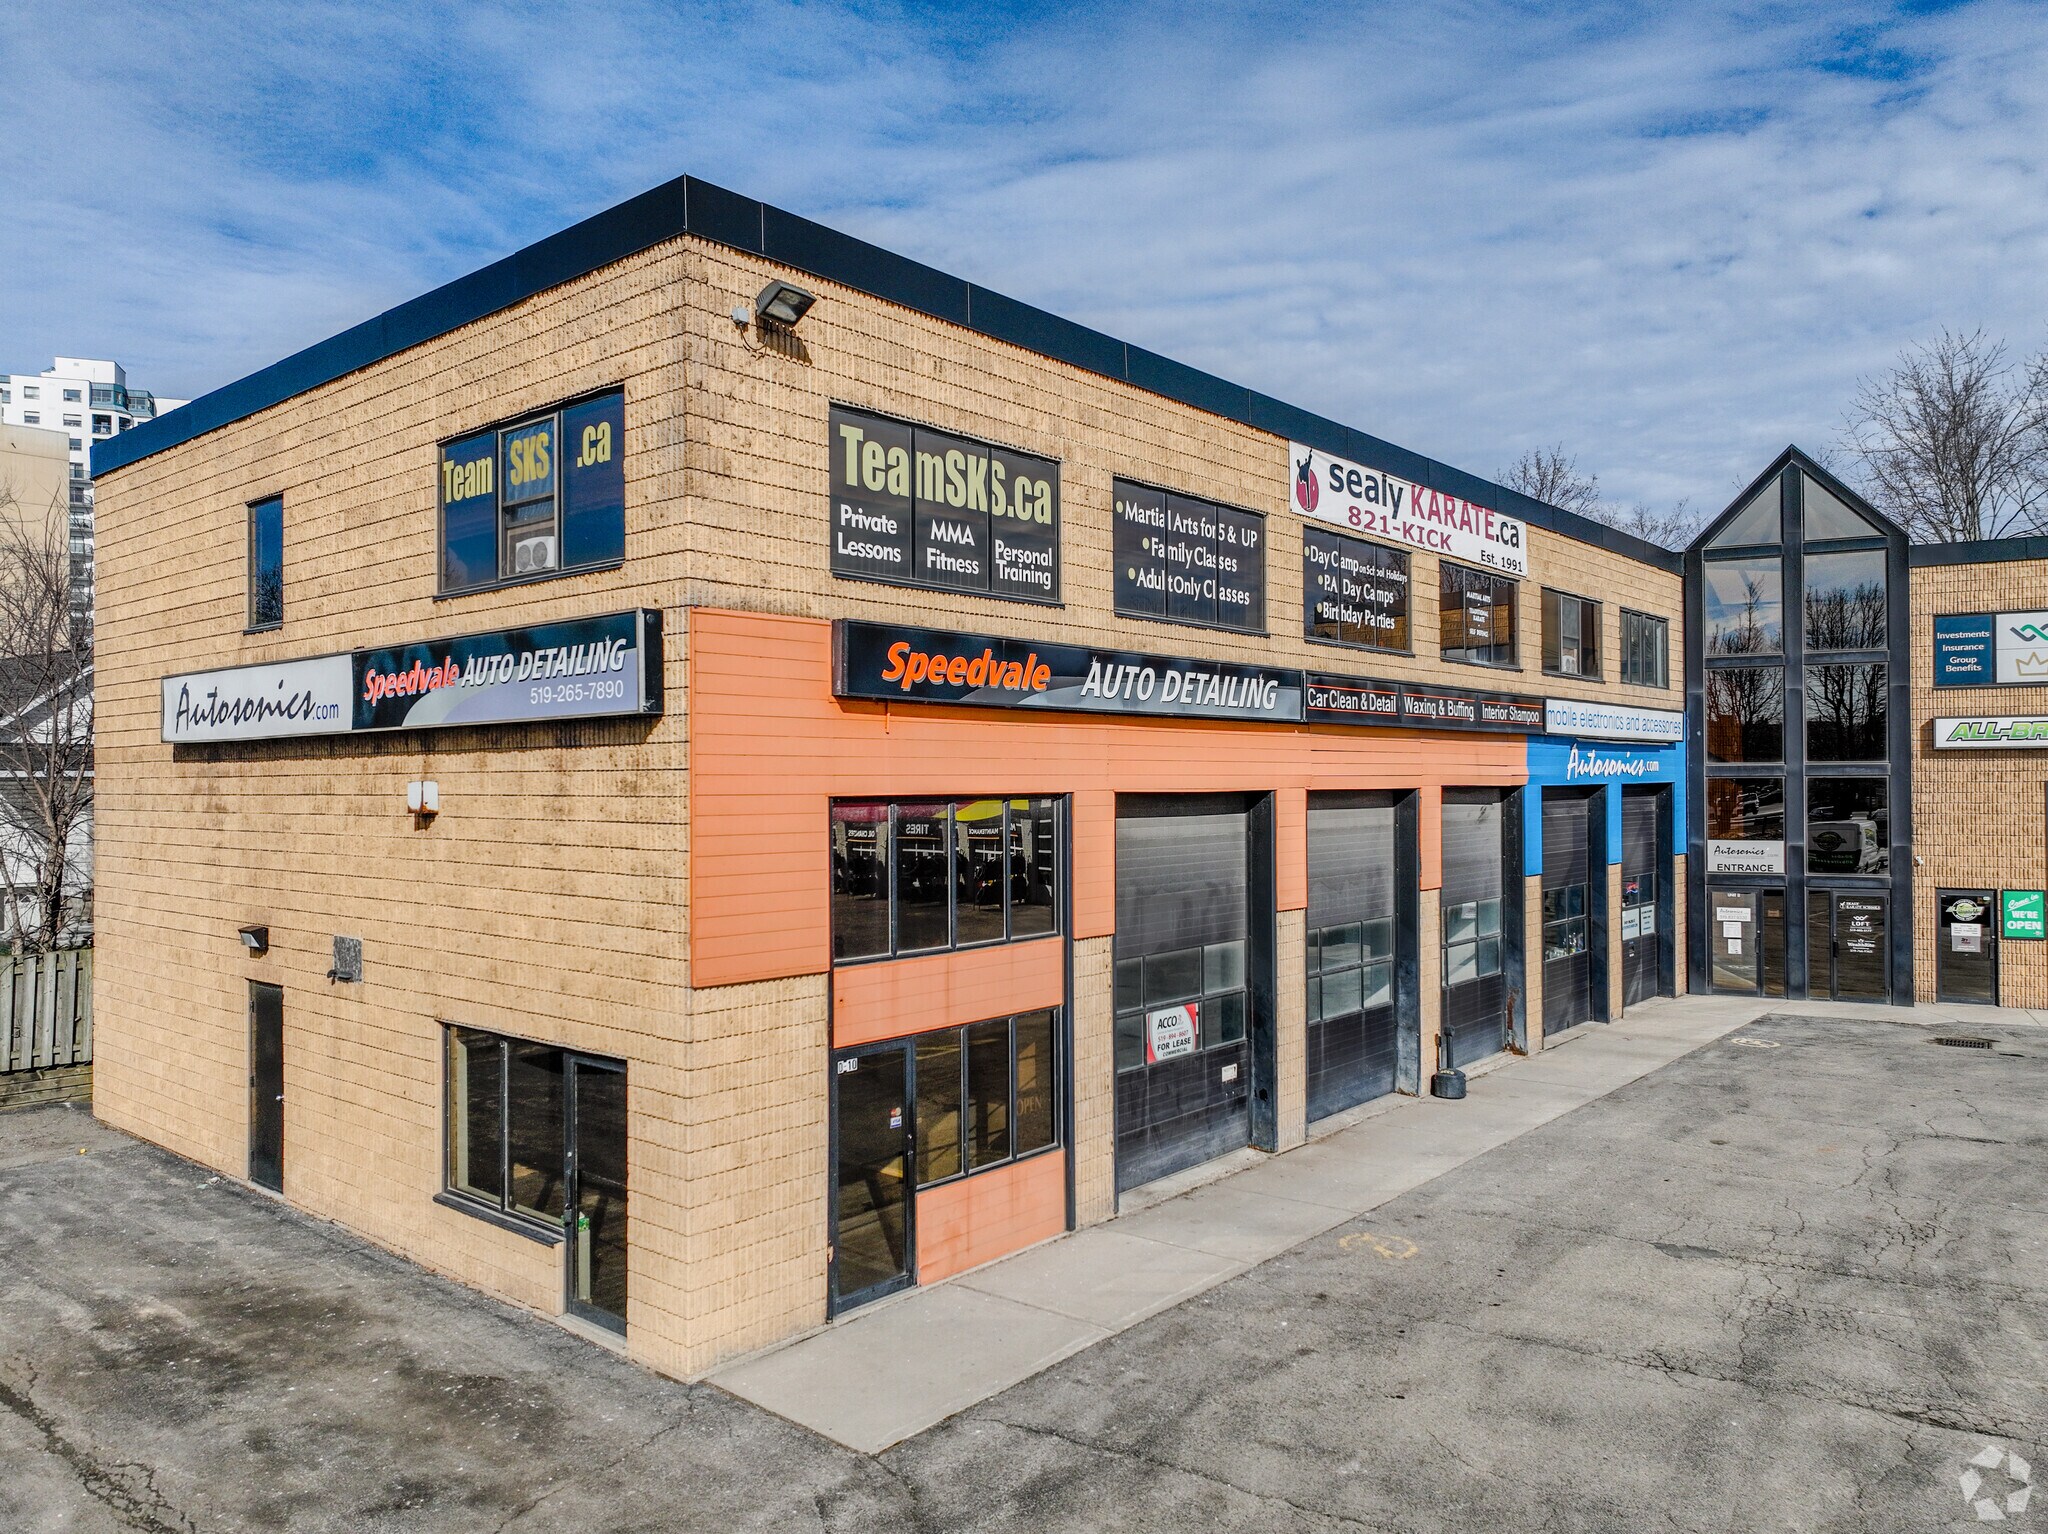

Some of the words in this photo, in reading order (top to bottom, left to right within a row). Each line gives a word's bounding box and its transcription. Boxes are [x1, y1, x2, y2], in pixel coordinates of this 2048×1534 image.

[443, 456, 493, 504] Team
[510, 432, 549, 486] SKS
[839, 423, 1052, 525] TeamSKS.ca
[840, 504, 897, 534] Private
[1329, 463, 1404, 519] sealy
[1410, 484, 1519, 549] KARATE.ca
[930, 519, 975, 546] MMA
[1125, 500, 1172, 530] Martial
[1173, 513, 1199, 536] Arts
[1200, 517, 1216, 539] for
[1218, 523, 1225, 541] 5
[1227, 525, 1237, 544] &
[1241, 528, 1258, 548] UP
[1348, 505, 1453, 551] 821-KICK
[838, 532, 901, 562] Lessons
[995, 539, 1052, 567] Personal
[1151, 537, 1192, 569] Family
[1194, 546, 1238, 572] Classes
[1480, 549, 1498, 566] Est.
[1501, 556, 1523, 572] 1991
[926, 547, 979, 575] Fitness
[995, 559, 1051, 590] Training
[1310, 545, 1330, 570] Day
[1331, 551, 1359, 576] Camp
[1359, 565, 1367, 573] on
[1367, 564, 1385, 578] School
[1385, 569, 1408, 584] Holidays
[1136, 567, 1173, 592] Adult
[1174, 576, 1201, 601] Only
[1203, 580, 1250, 605] Classes
[1343, 578, 1362, 602] Day
[1363, 583, 1394, 607] Camps
[1322, 602, 1363, 628] Birthday
[1365, 609, 1395, 629] Parties
[1937, 630, 1990, 639] Investments
[1942, 643, 1985, 651] Insurance
[363, 656, 459, 706] Speedvale
[461, 653, 515, 687] AUTO
[517, 636, 627, 683] DETAILING
[1945, 664, 1982, 672] Benefits
[1949, 656, 1978, 664] Group
[881, 641, 1051, 692] Speedvale
[1080, 656, 1155, 700] AUTO
[1160, 672, 1279, 710] DETAILING
[530, 680, 624, 705] 519-265-7890
[1307, 688, 1328, 707] Car
[1329, 690, 1359, 710] Clean
[1360, 692, 1367, 711] &
[1369, 693, 1397, 713] Detail
[1404, 697, 1436, 719] Waxing
[1438, 701, 1445, 715] &
[1447, 701, 1474, 721] Buffing
[1482, 703, 1508, 720] Interior
[1509, 707, 1540, 725] Shampoo
[1547, 706, 1577, 727] mobile
[1580, 709, 1624, 730] electronics
[1625, 713, 1640, 731] and
[1642, 716, 1682, 734] accessories
[1717, 863, 1774, 872] ENTRANCE
[2007, 921, 2042, 930] OPEN
[2011, 910, 2038, 919] WE'RE
[1157, 1015, 1177, 1030] ACCO
[1157, 1042, 1170, 1051] FOR
[1172, 1037, 1191, 1048] LEASE
[1163, 1048, 1188, 1057] COMMERCIAL
[1016, 1096, 1042, 1116] OPEN
